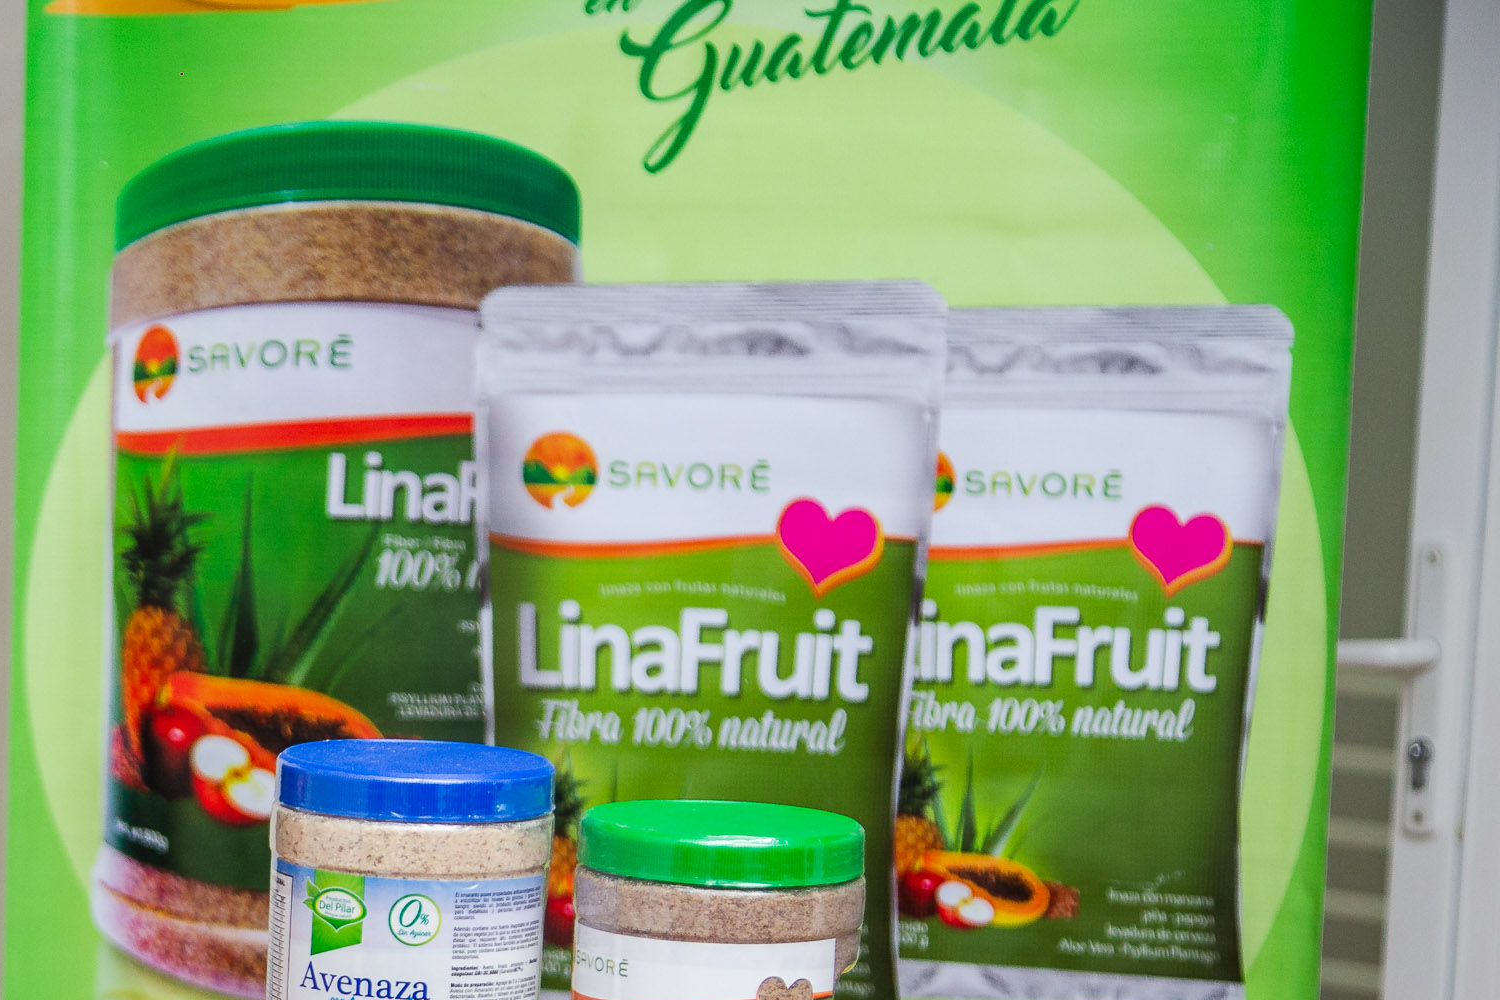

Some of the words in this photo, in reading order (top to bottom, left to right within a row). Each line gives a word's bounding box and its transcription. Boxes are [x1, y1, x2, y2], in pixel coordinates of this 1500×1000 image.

[620, 0, 1081, 174] Guatemala
[377, 549, 461, 591] 100%
[517, 599, 874, 703] LinaFruit
[912, 598, 1221, 693] inaFruit
[536, 699, 623, 745] Fibra
[633, 707, 713, 750] 100%
[718, 708, 848, 754] natural
[987, 697, 1067, 738] 100%
[1071, 698, 1196, 743] natural
[319, 900, 334, 910] Del
[335, 902, 356, 914] Pilar
[399, 899, 430, 928] 0%
